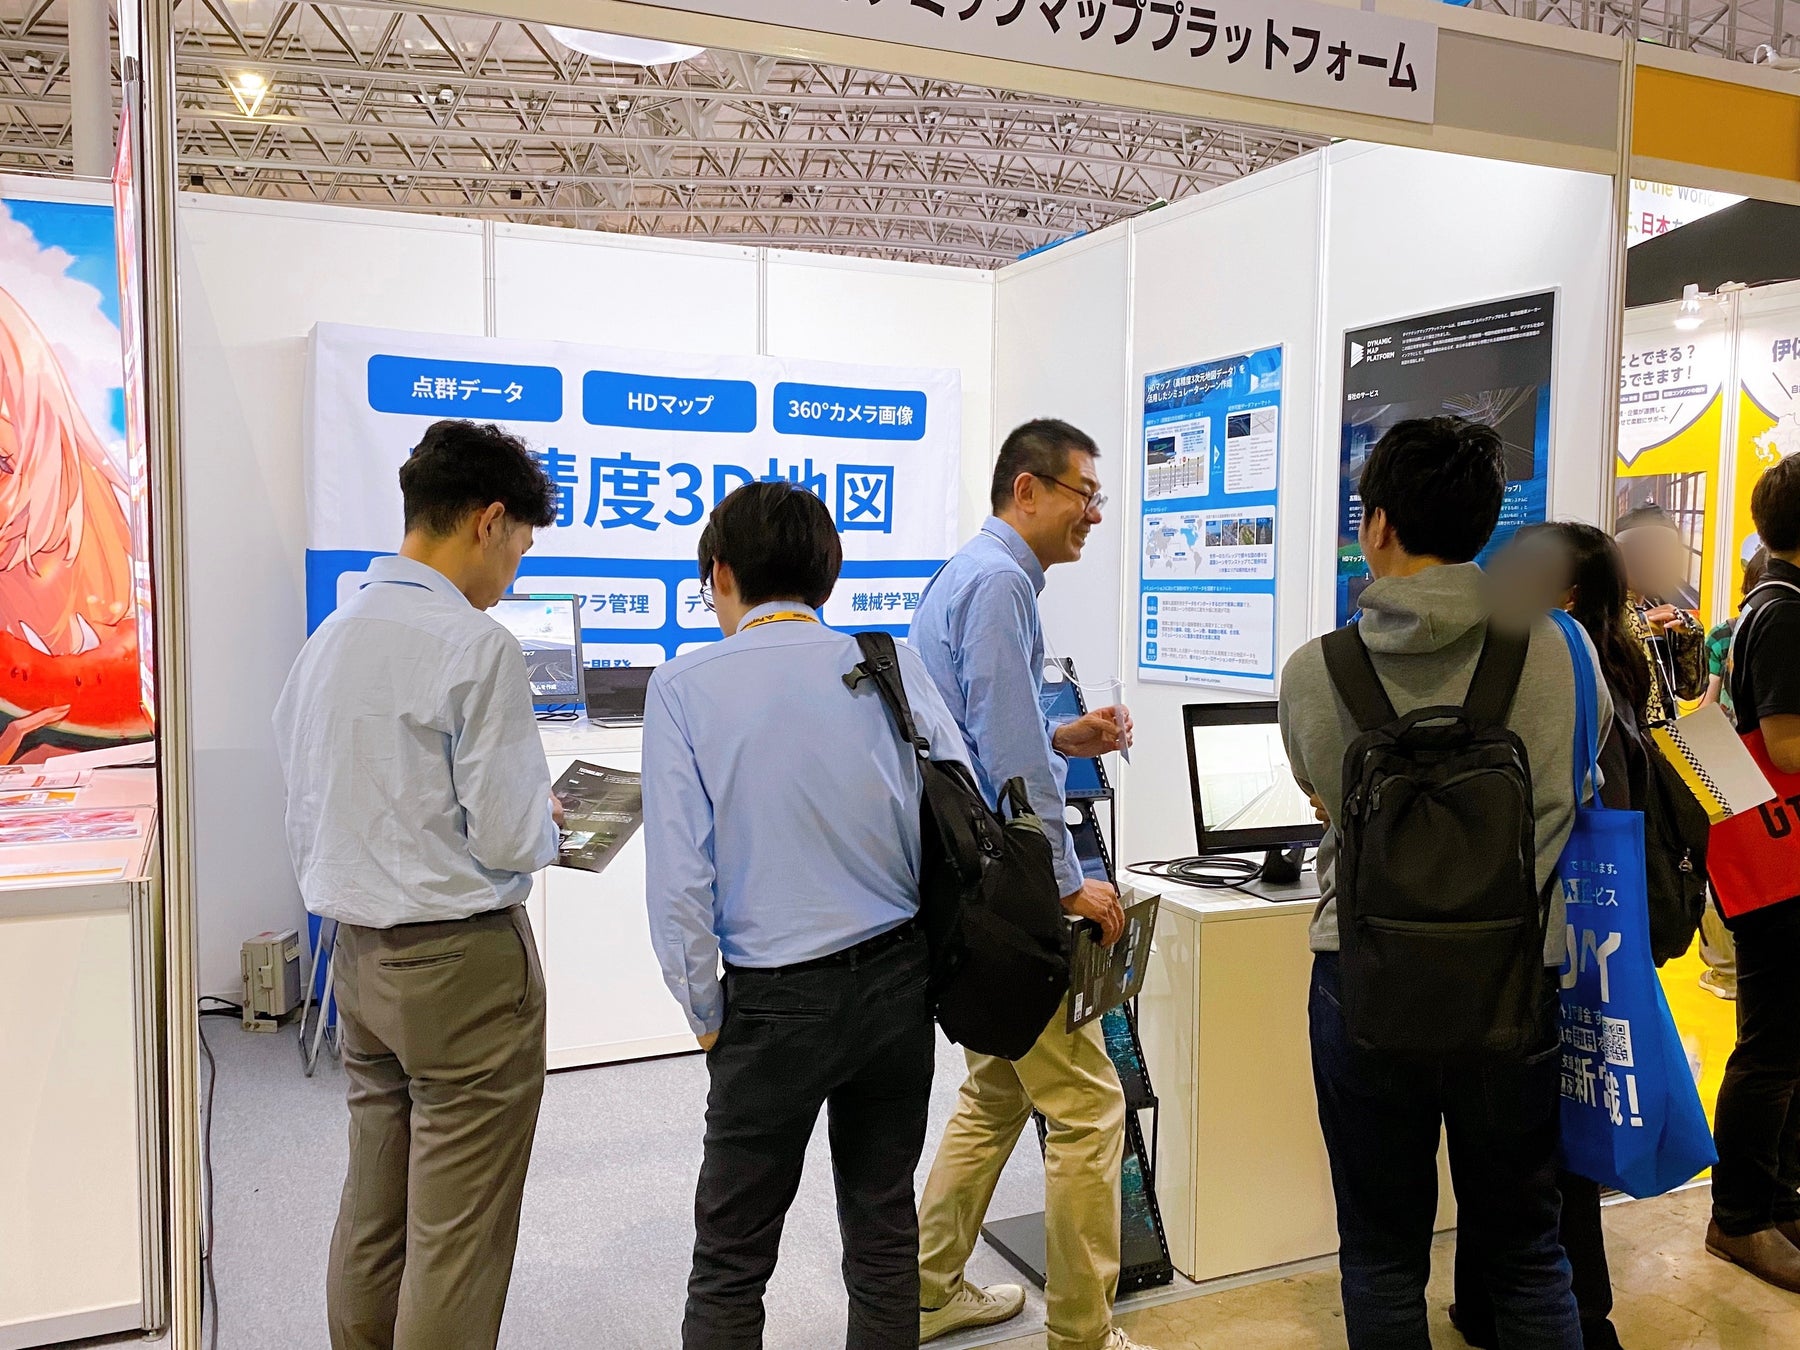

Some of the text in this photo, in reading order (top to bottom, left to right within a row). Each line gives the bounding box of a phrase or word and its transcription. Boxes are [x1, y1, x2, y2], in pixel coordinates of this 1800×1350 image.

[1367, 337, 1393, 348] DYNAMIC
[1367, 347, 1379, 355] MAP
[1366, 351, 1396, 362] PLATFORM
[411, 375, 525, 404] 点群データ
[627, 391, 715, 417] HDマップ
[787, 397, 914, 426] 360°カメラ画像
[852, 592, 920, 612] 機械学習
